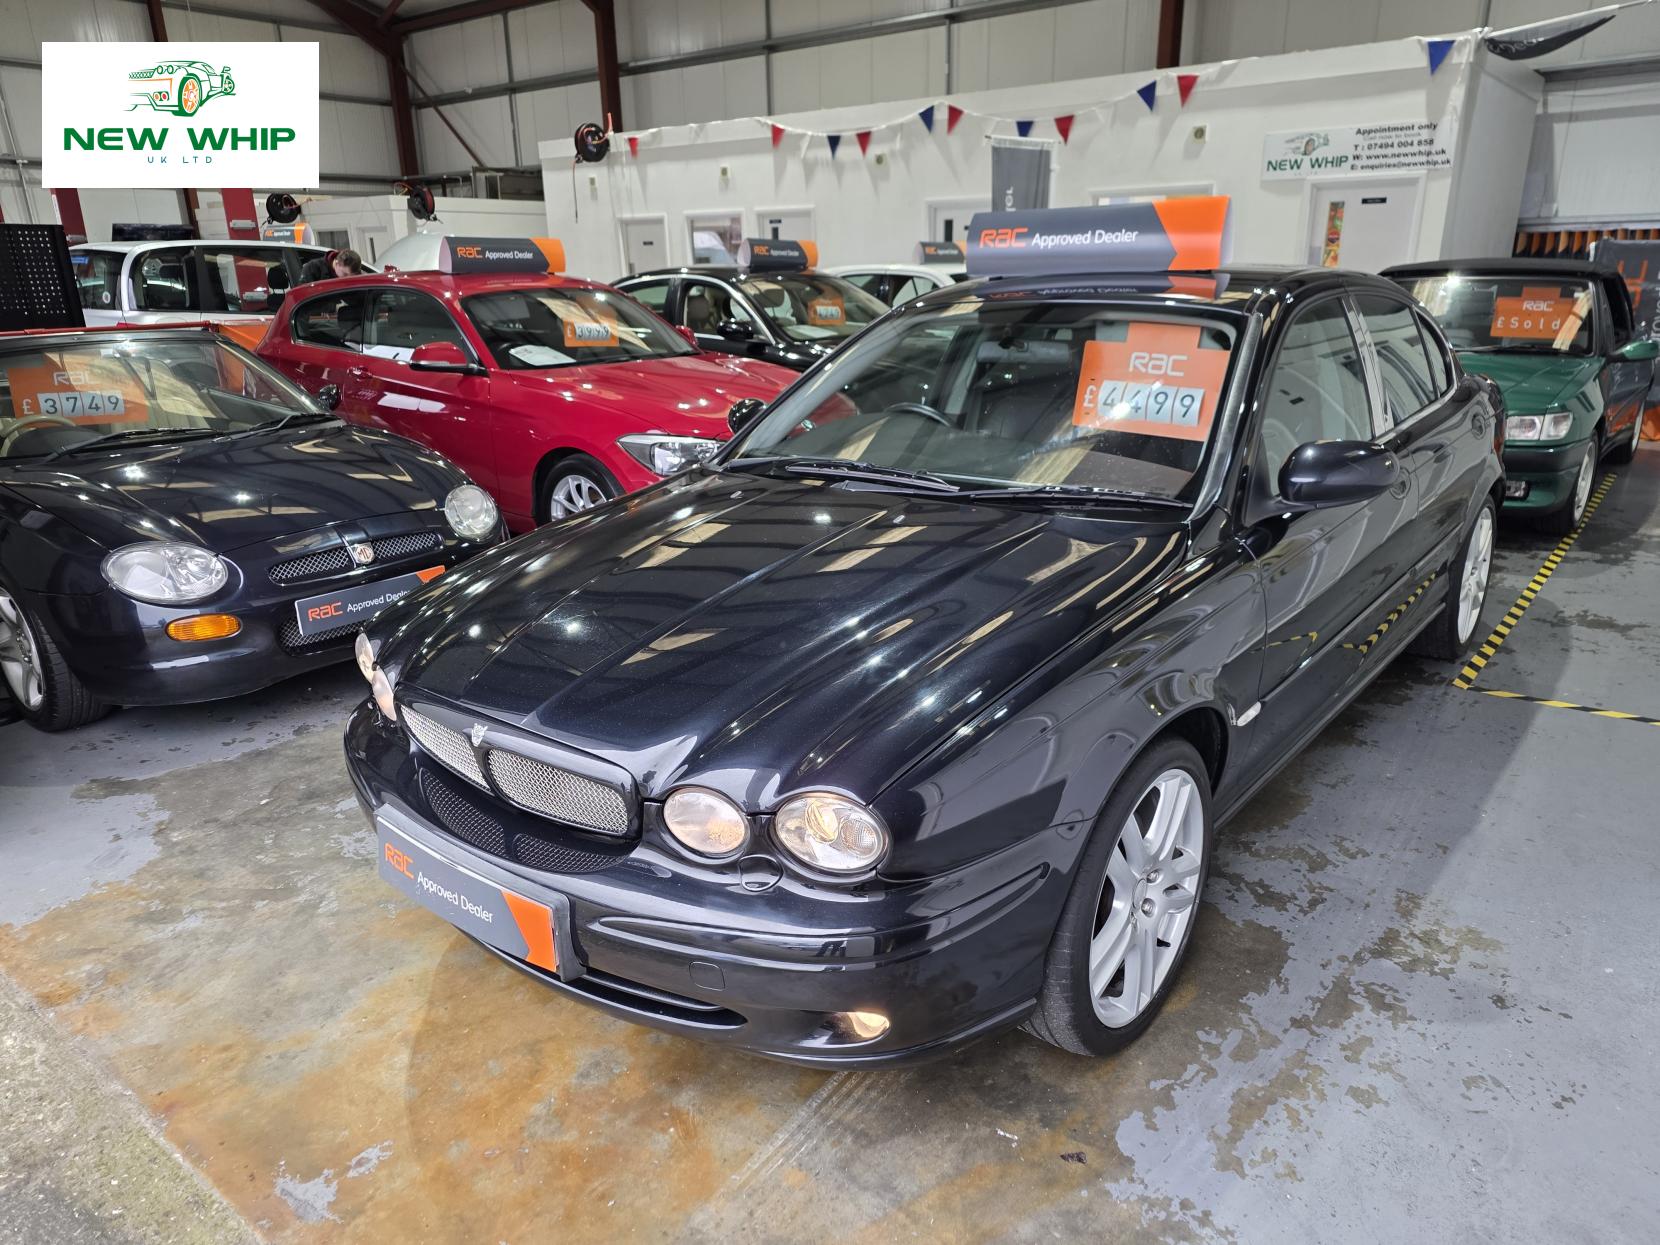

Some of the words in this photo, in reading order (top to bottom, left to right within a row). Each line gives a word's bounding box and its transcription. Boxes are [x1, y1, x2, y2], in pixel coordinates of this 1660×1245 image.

[1355, 124, 1416, 136] Appointment
[1417, 122, 1438, 131] only
[1397, 139, 1414, 148] 004
[1365, 148, 1446, 160] www.newwhip.uk
[1266, 159, 1303, 172] NEW
[1309, 155, 1349, 170] WHIP
[1031, 230, 1092, 249] Approved
[1094, 229, 1139, 244] Dealer
[485, 250, 513, 260] Approved
[514, 251, 533, 259] Dealer
[347, 595, 385, 613] Approved
[386, 590, 411, 602] Deale
[417, 872, 459, 905] Approved
[460, 896, 493, 924] Dealer
